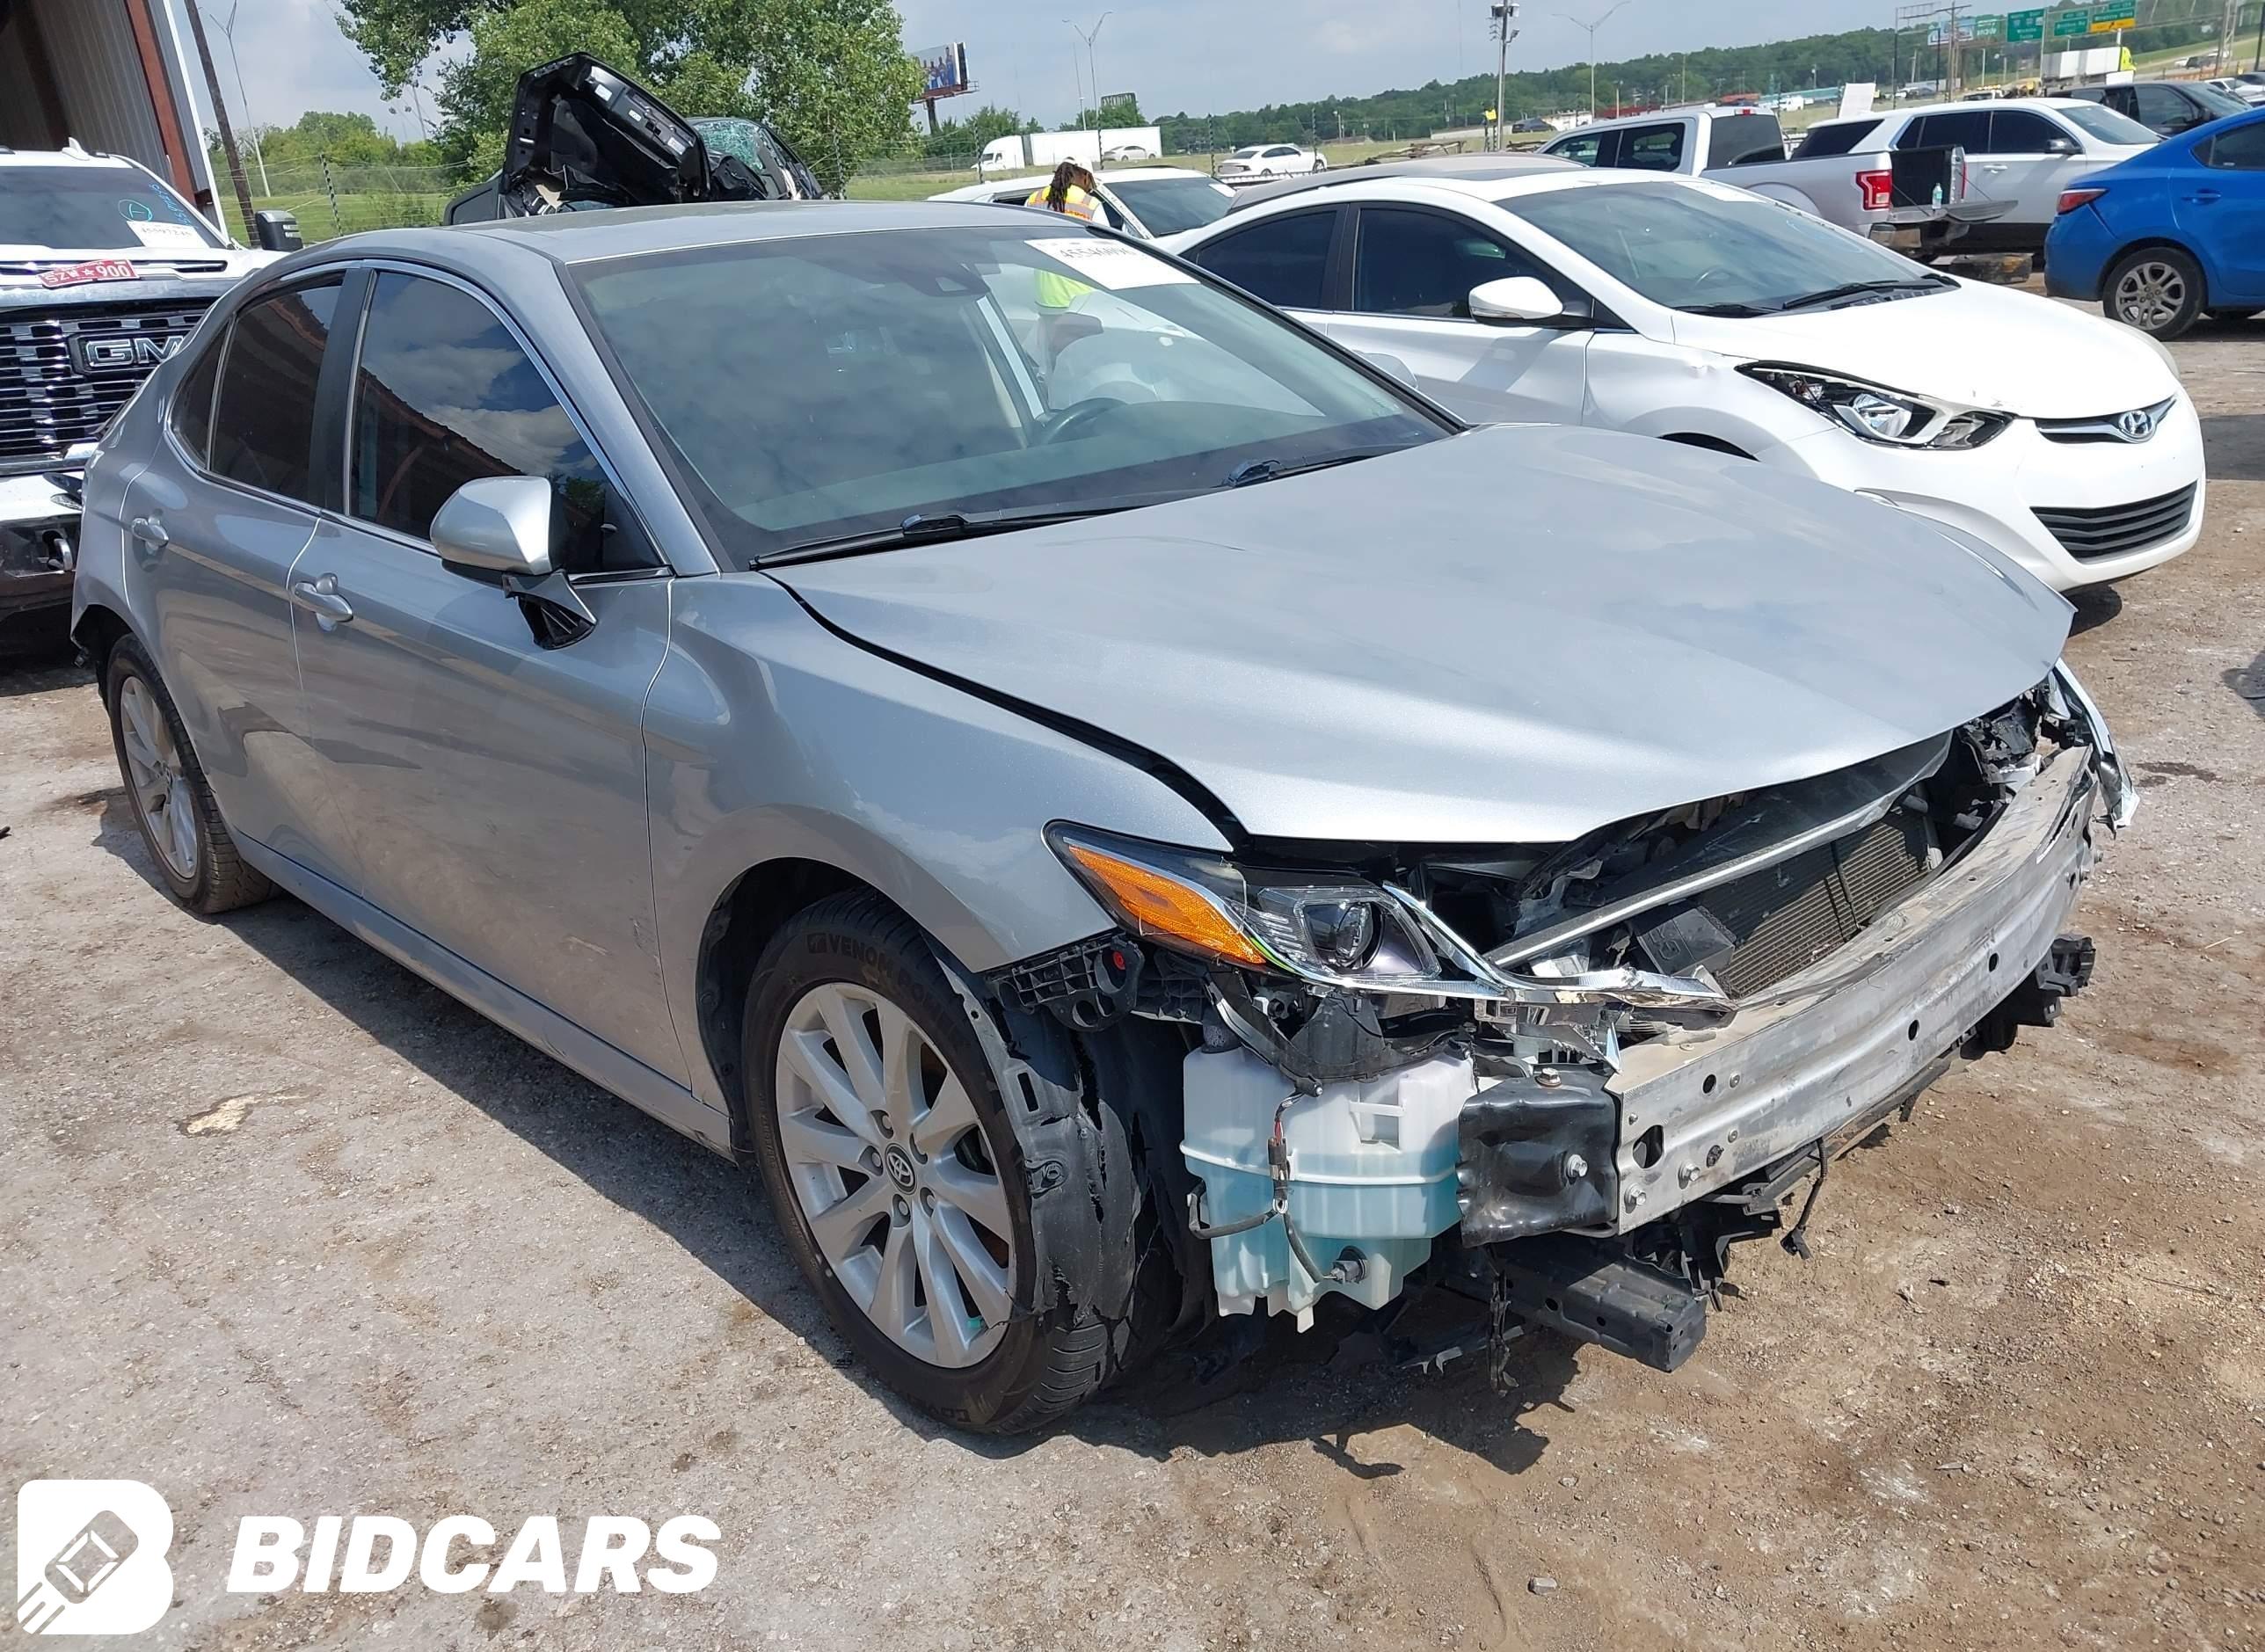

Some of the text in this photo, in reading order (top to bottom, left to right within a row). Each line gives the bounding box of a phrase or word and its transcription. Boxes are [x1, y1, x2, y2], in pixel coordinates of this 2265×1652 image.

[96, 266, 131, 278] 900
[86, 335, 184, 367] GM
[827, 933, 895, 979] VENOM
